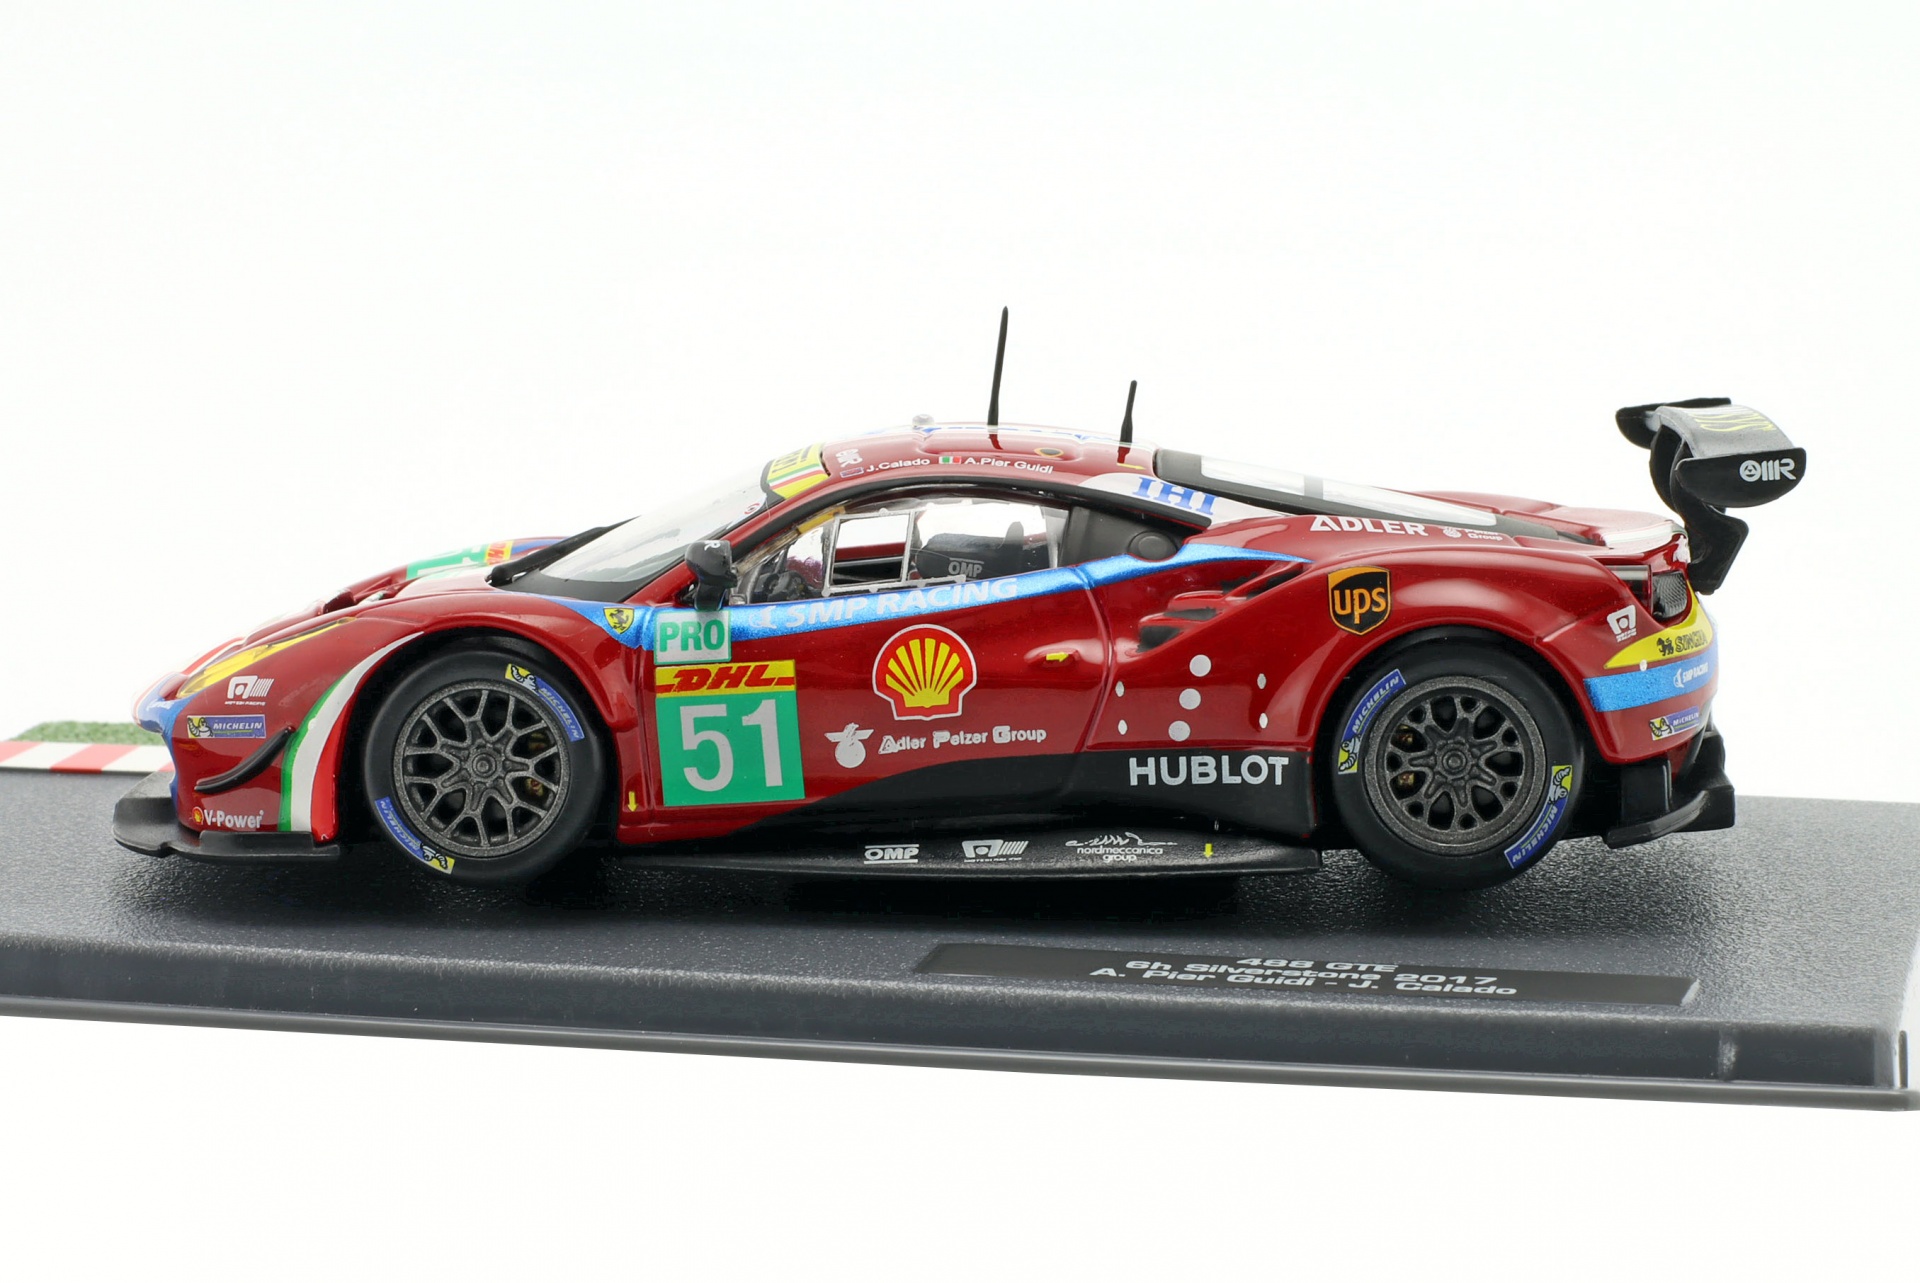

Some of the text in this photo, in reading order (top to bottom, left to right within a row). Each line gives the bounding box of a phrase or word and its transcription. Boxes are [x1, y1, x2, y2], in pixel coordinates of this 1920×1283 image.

[866, 457, 930, 473] J.Calado
[964, 457, 1053, 474] A.Pier Guidi
[1132, 476, 1217, 515] IHI
[1310, 515, 1429, 536] ADLER
[948, 561, 983, 577] OMP
[786, 578, 1018, 628] SMP RACING
[659, 619, 726, 652] PRO
[670, 664, 775, 693] DHL
[540, 687, 580, 738] MICHELIN
[1352, 676, 1399, 734] MICHELIN
[213, 722, 262, 730] MICHELIN
[1672, 711, 1699, 726] MICHELIN
[680, 699, 783, 791] 51
[878, 725, 1047, 755] Adler Pelzer Group
[1129, 755, 1289, 786] HUBLOT
[1512, 805, 1558, 862] MICHELIN
[864, 848, 920, 861] OMP
[1077, 845, 1164, 856] nordmeccanica
[1102, 853, 1138, 863] group
[1125, 961, 1498, 985] 6h Silverstone 2017
[1236, 958, 1399, 972] 488 GTE
[1089, 967, 1126, 978] A.
[1142, 970, 1217, 982] Pier
[1226, 974, 1316, 986] Guidi
[1348, 980, 1379, 989] J.
[1396, 982, 1517, 995] Calado
